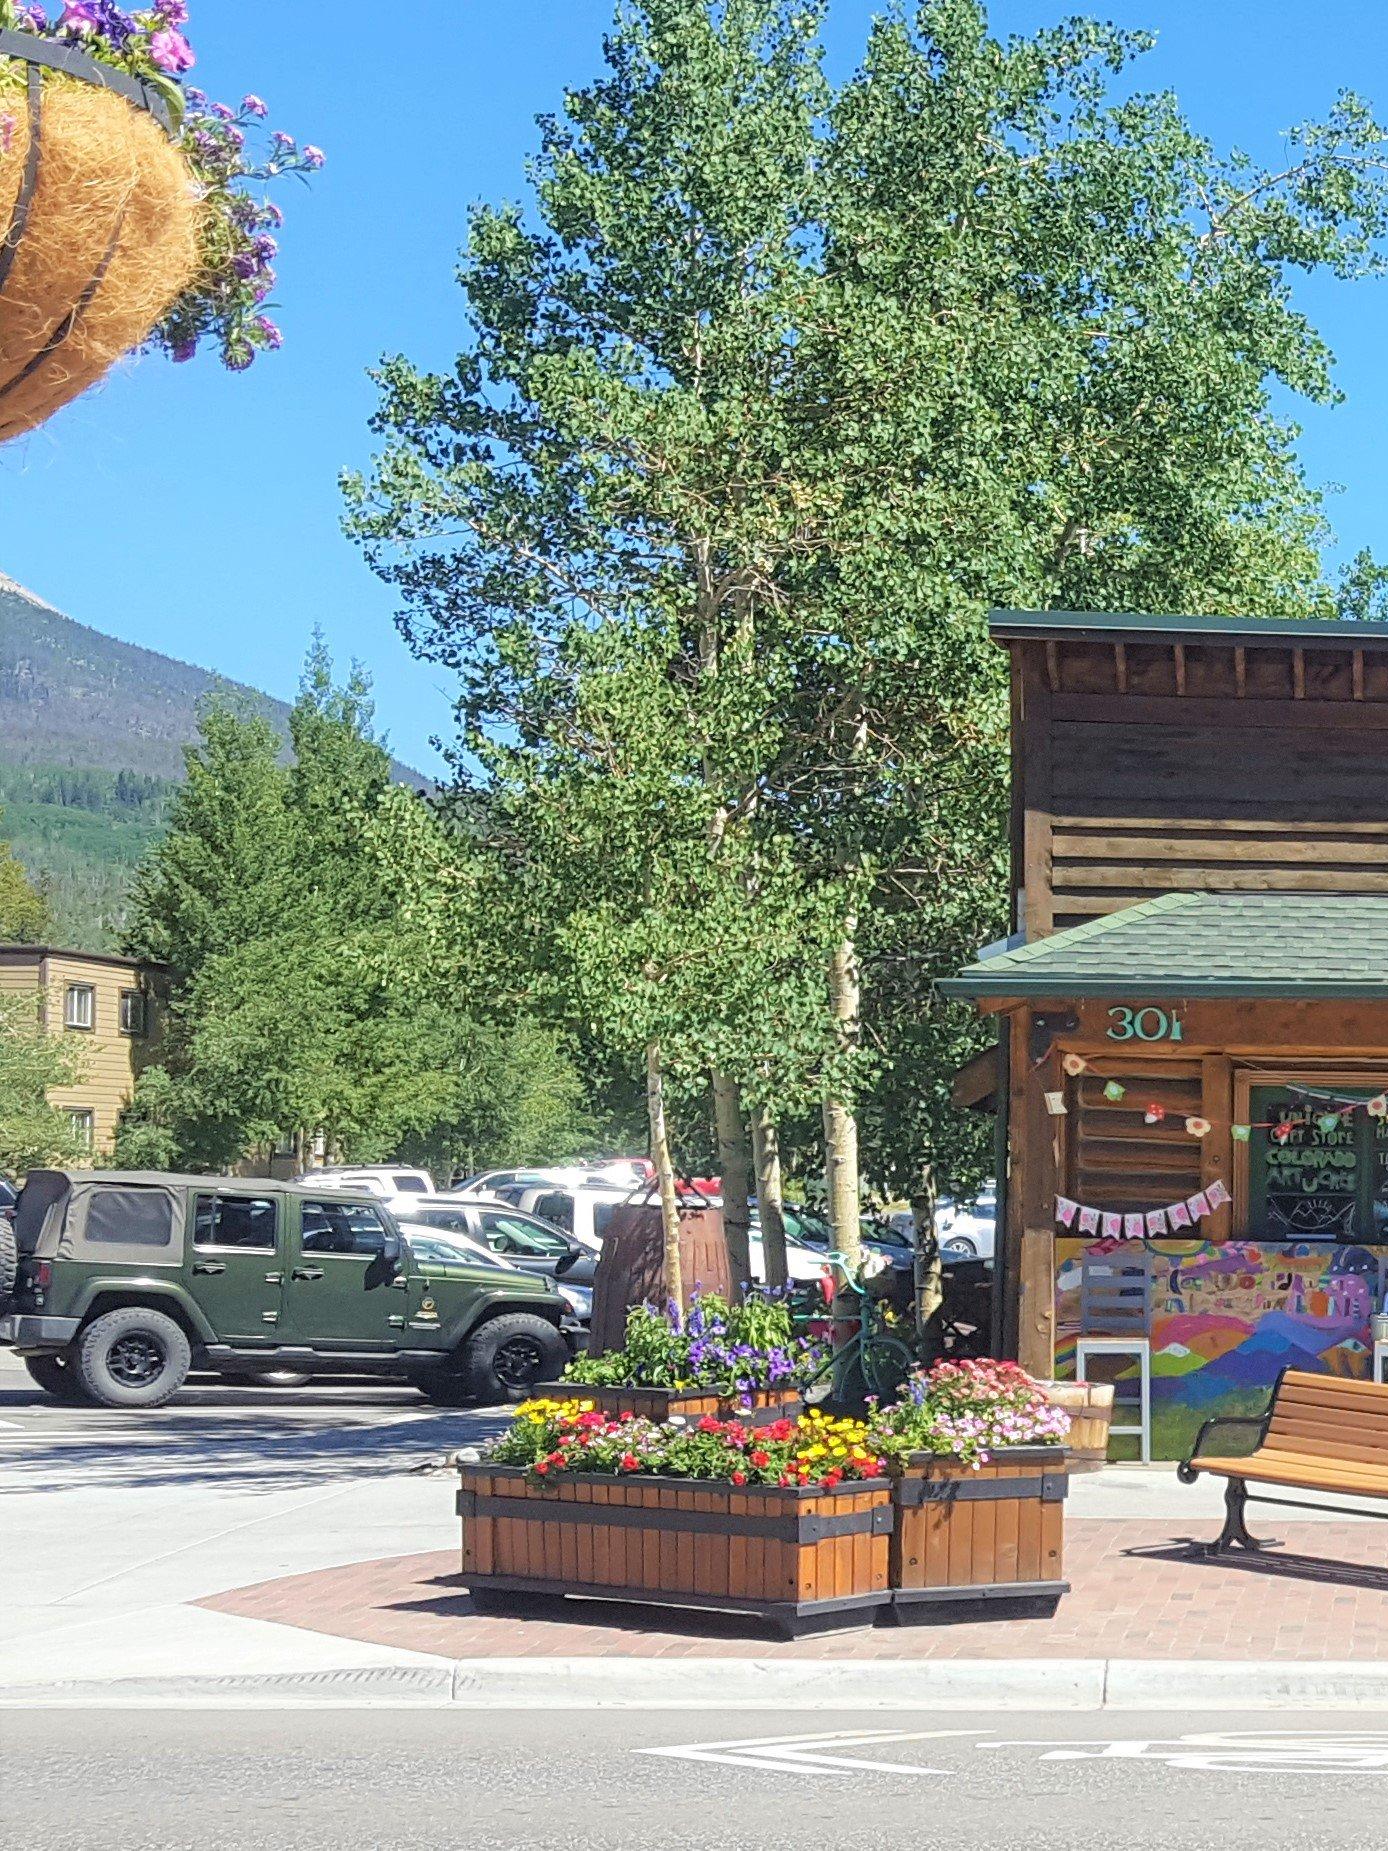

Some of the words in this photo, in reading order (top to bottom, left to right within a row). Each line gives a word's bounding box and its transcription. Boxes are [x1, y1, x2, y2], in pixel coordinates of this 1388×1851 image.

[1106, 1006, 1183, 1041] 301
[1270, 1127, 1305, 1144] GFT
[1266, 1149, 1356, 1169] COLORADO
